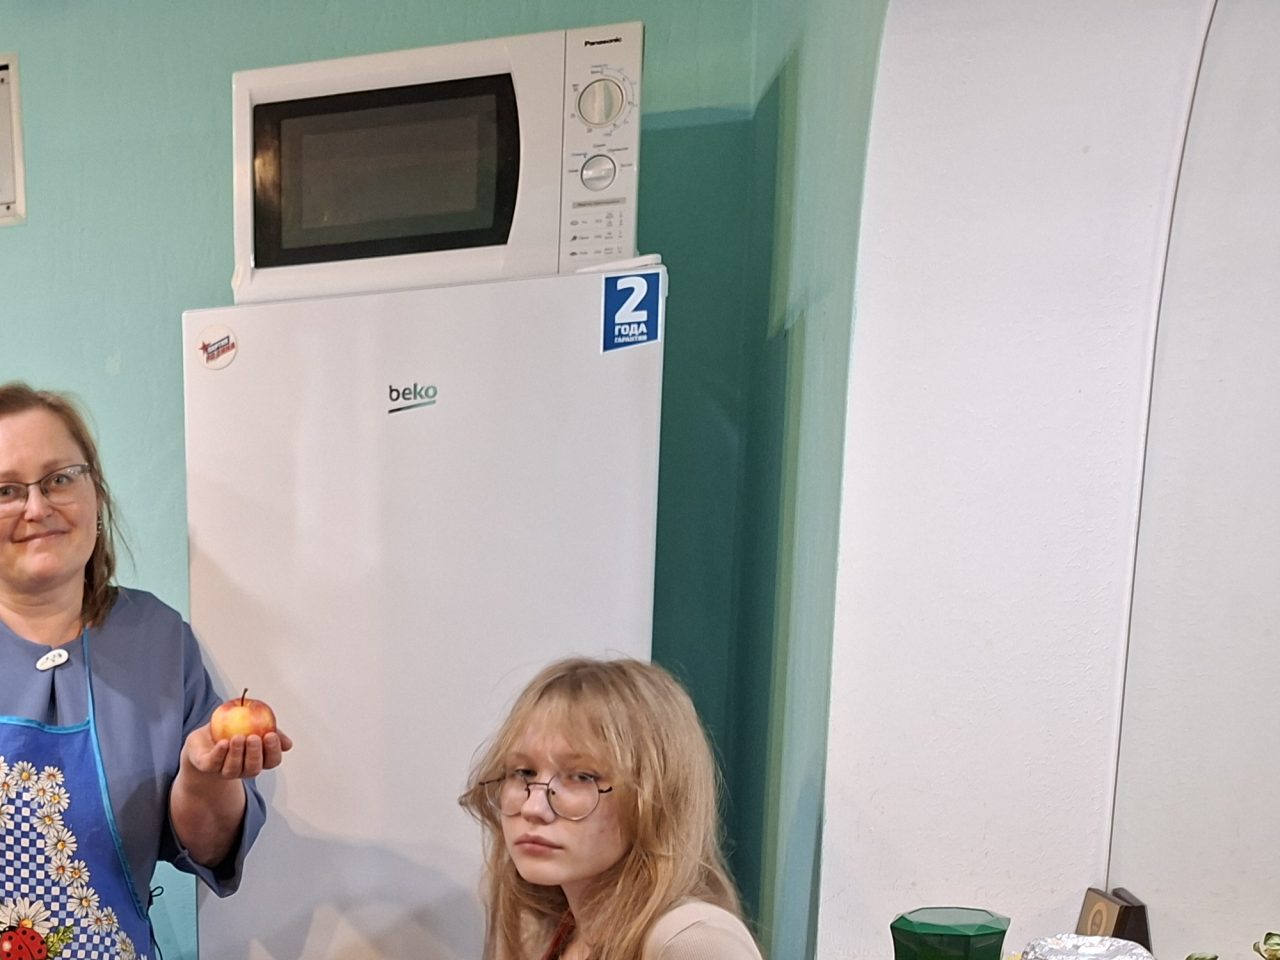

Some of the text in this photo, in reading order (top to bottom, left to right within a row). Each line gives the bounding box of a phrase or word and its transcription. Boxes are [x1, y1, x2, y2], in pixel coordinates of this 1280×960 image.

[584, 36, 622, 47] Panasonic
[614, 276, 648, 324] 2
[614, 323, 648, 337] ГОДА
[388, 382, 438, 402] beko
